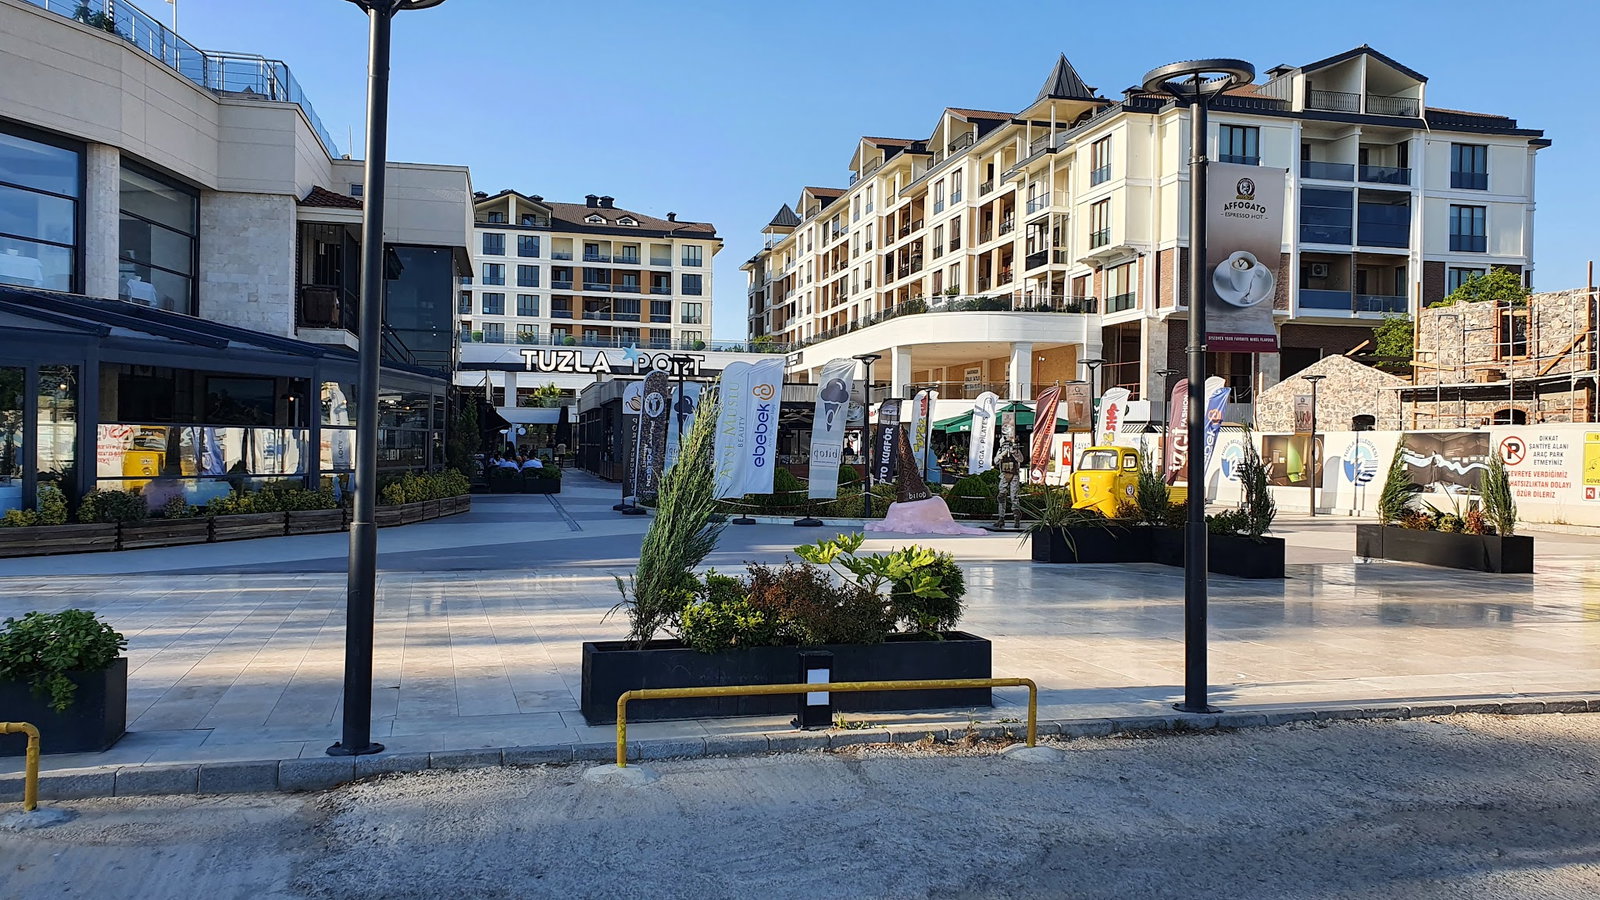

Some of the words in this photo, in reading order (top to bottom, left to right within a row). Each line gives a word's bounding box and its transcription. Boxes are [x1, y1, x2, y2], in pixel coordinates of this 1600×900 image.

[1223, 201, 1266, 214] AFFOGATO
[1224, 211, 1250, 219] ESPRESSO
[520, 350, 612, 374] TUZLA
[722, 382, 740, 437] MUSLU
[737, 416, 745, 448] BEAUTY
[752, 403, 770, 468] ebebek
[881, 427, 894, 464] KUAFÖR
[1550, 481, 1571, 489] DOLAYI
